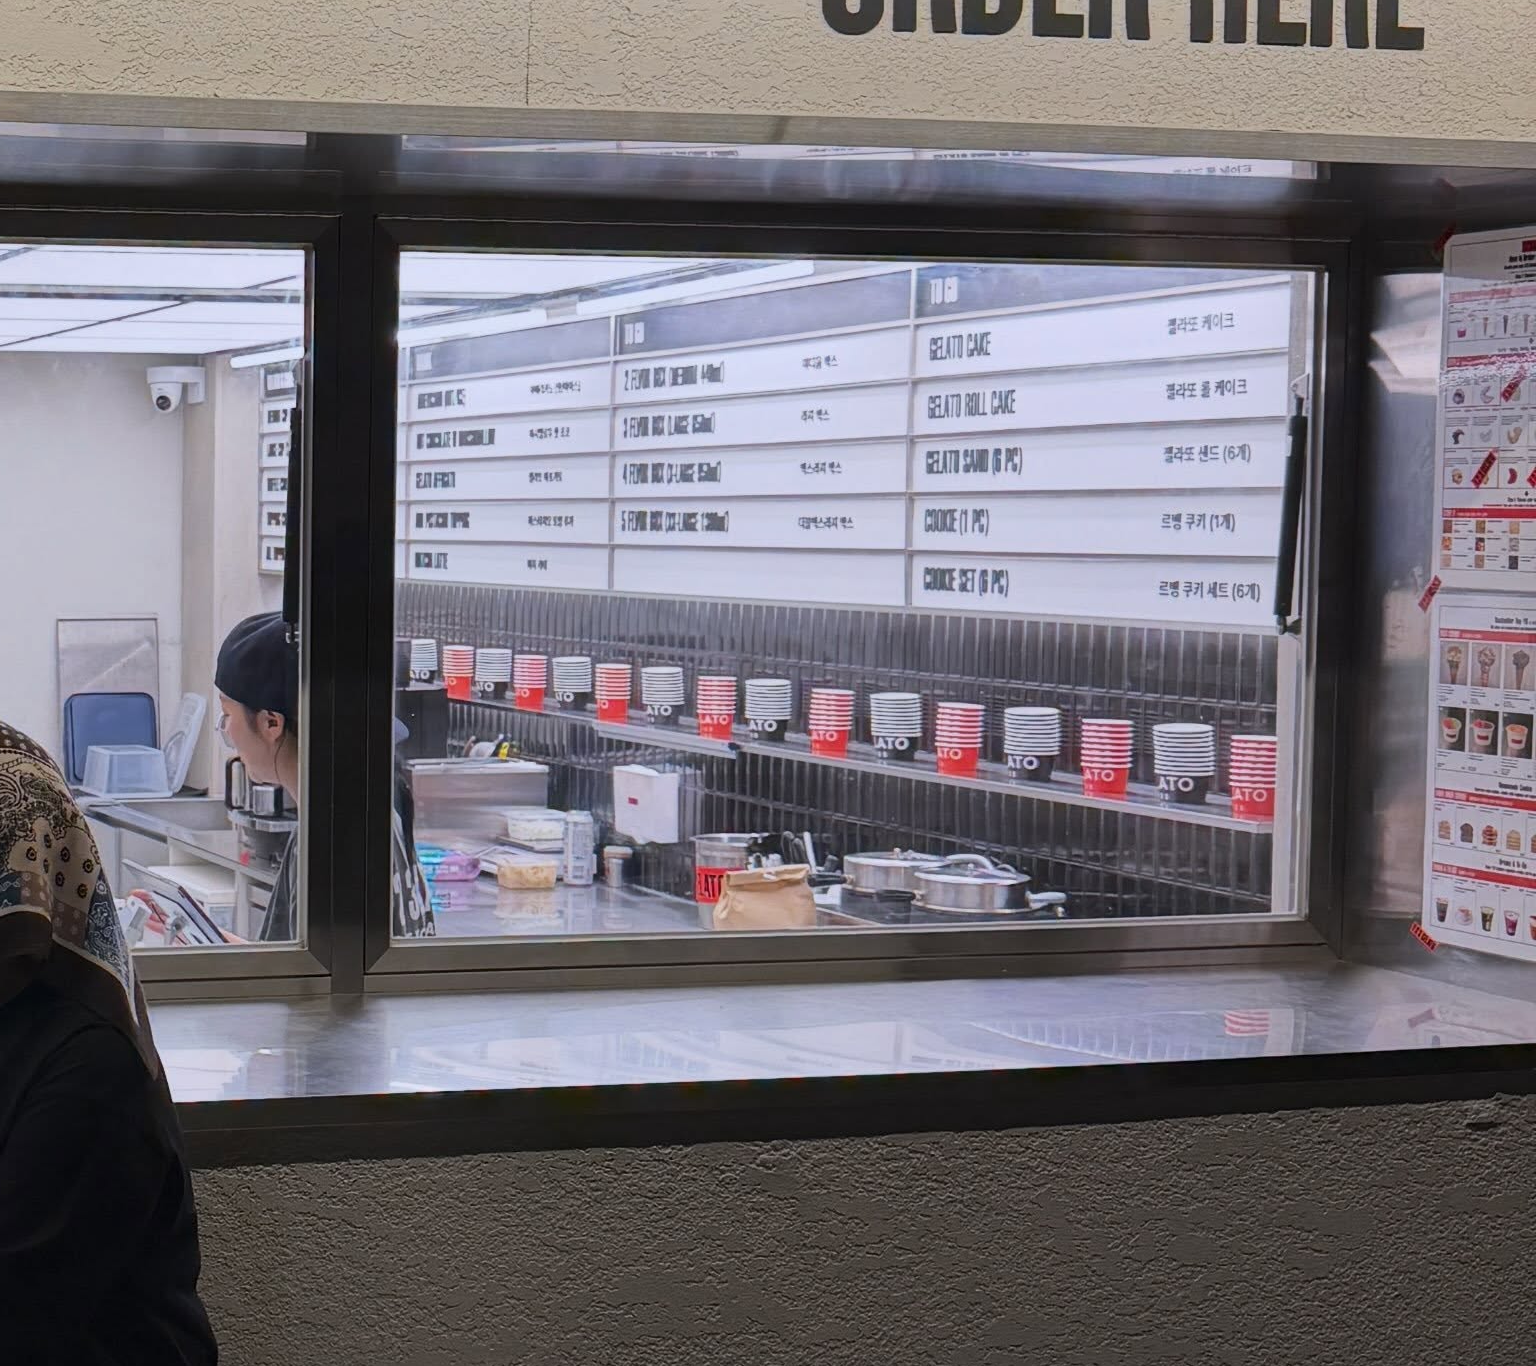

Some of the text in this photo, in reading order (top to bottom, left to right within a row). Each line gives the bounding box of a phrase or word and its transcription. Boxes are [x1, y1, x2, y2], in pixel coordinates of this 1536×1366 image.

[1202, 312, 1235, 331] 케이크
[929, 332, 992, 361] GELATO CAKE
[1214, 378, 1248, 397] 케이크
[928, 389, 1016, 419] GELATO ROLL CAKE
[926, 449, 960, 474] GELATO
[1004, 446, 1023, 476] PC)
[1223, 443, 1251, 464] (6개)
[925, 508, 958, 532] COOKIE
[972, 508, 990, 537] PC)
[1184, 513, 1206, 531] 쿠키
[1210, 513, 1236, 533] (1개)
[924, 567, 957, 592] COOKIE
[958, 568, 977, 593] SET
[991, 569, 1009, 598] PC)
[1183, 580, 1204, 599] 쿠키
[1207, 580, 1229, 599] 세트
[1231, 582, 1261, 603] (6개)
